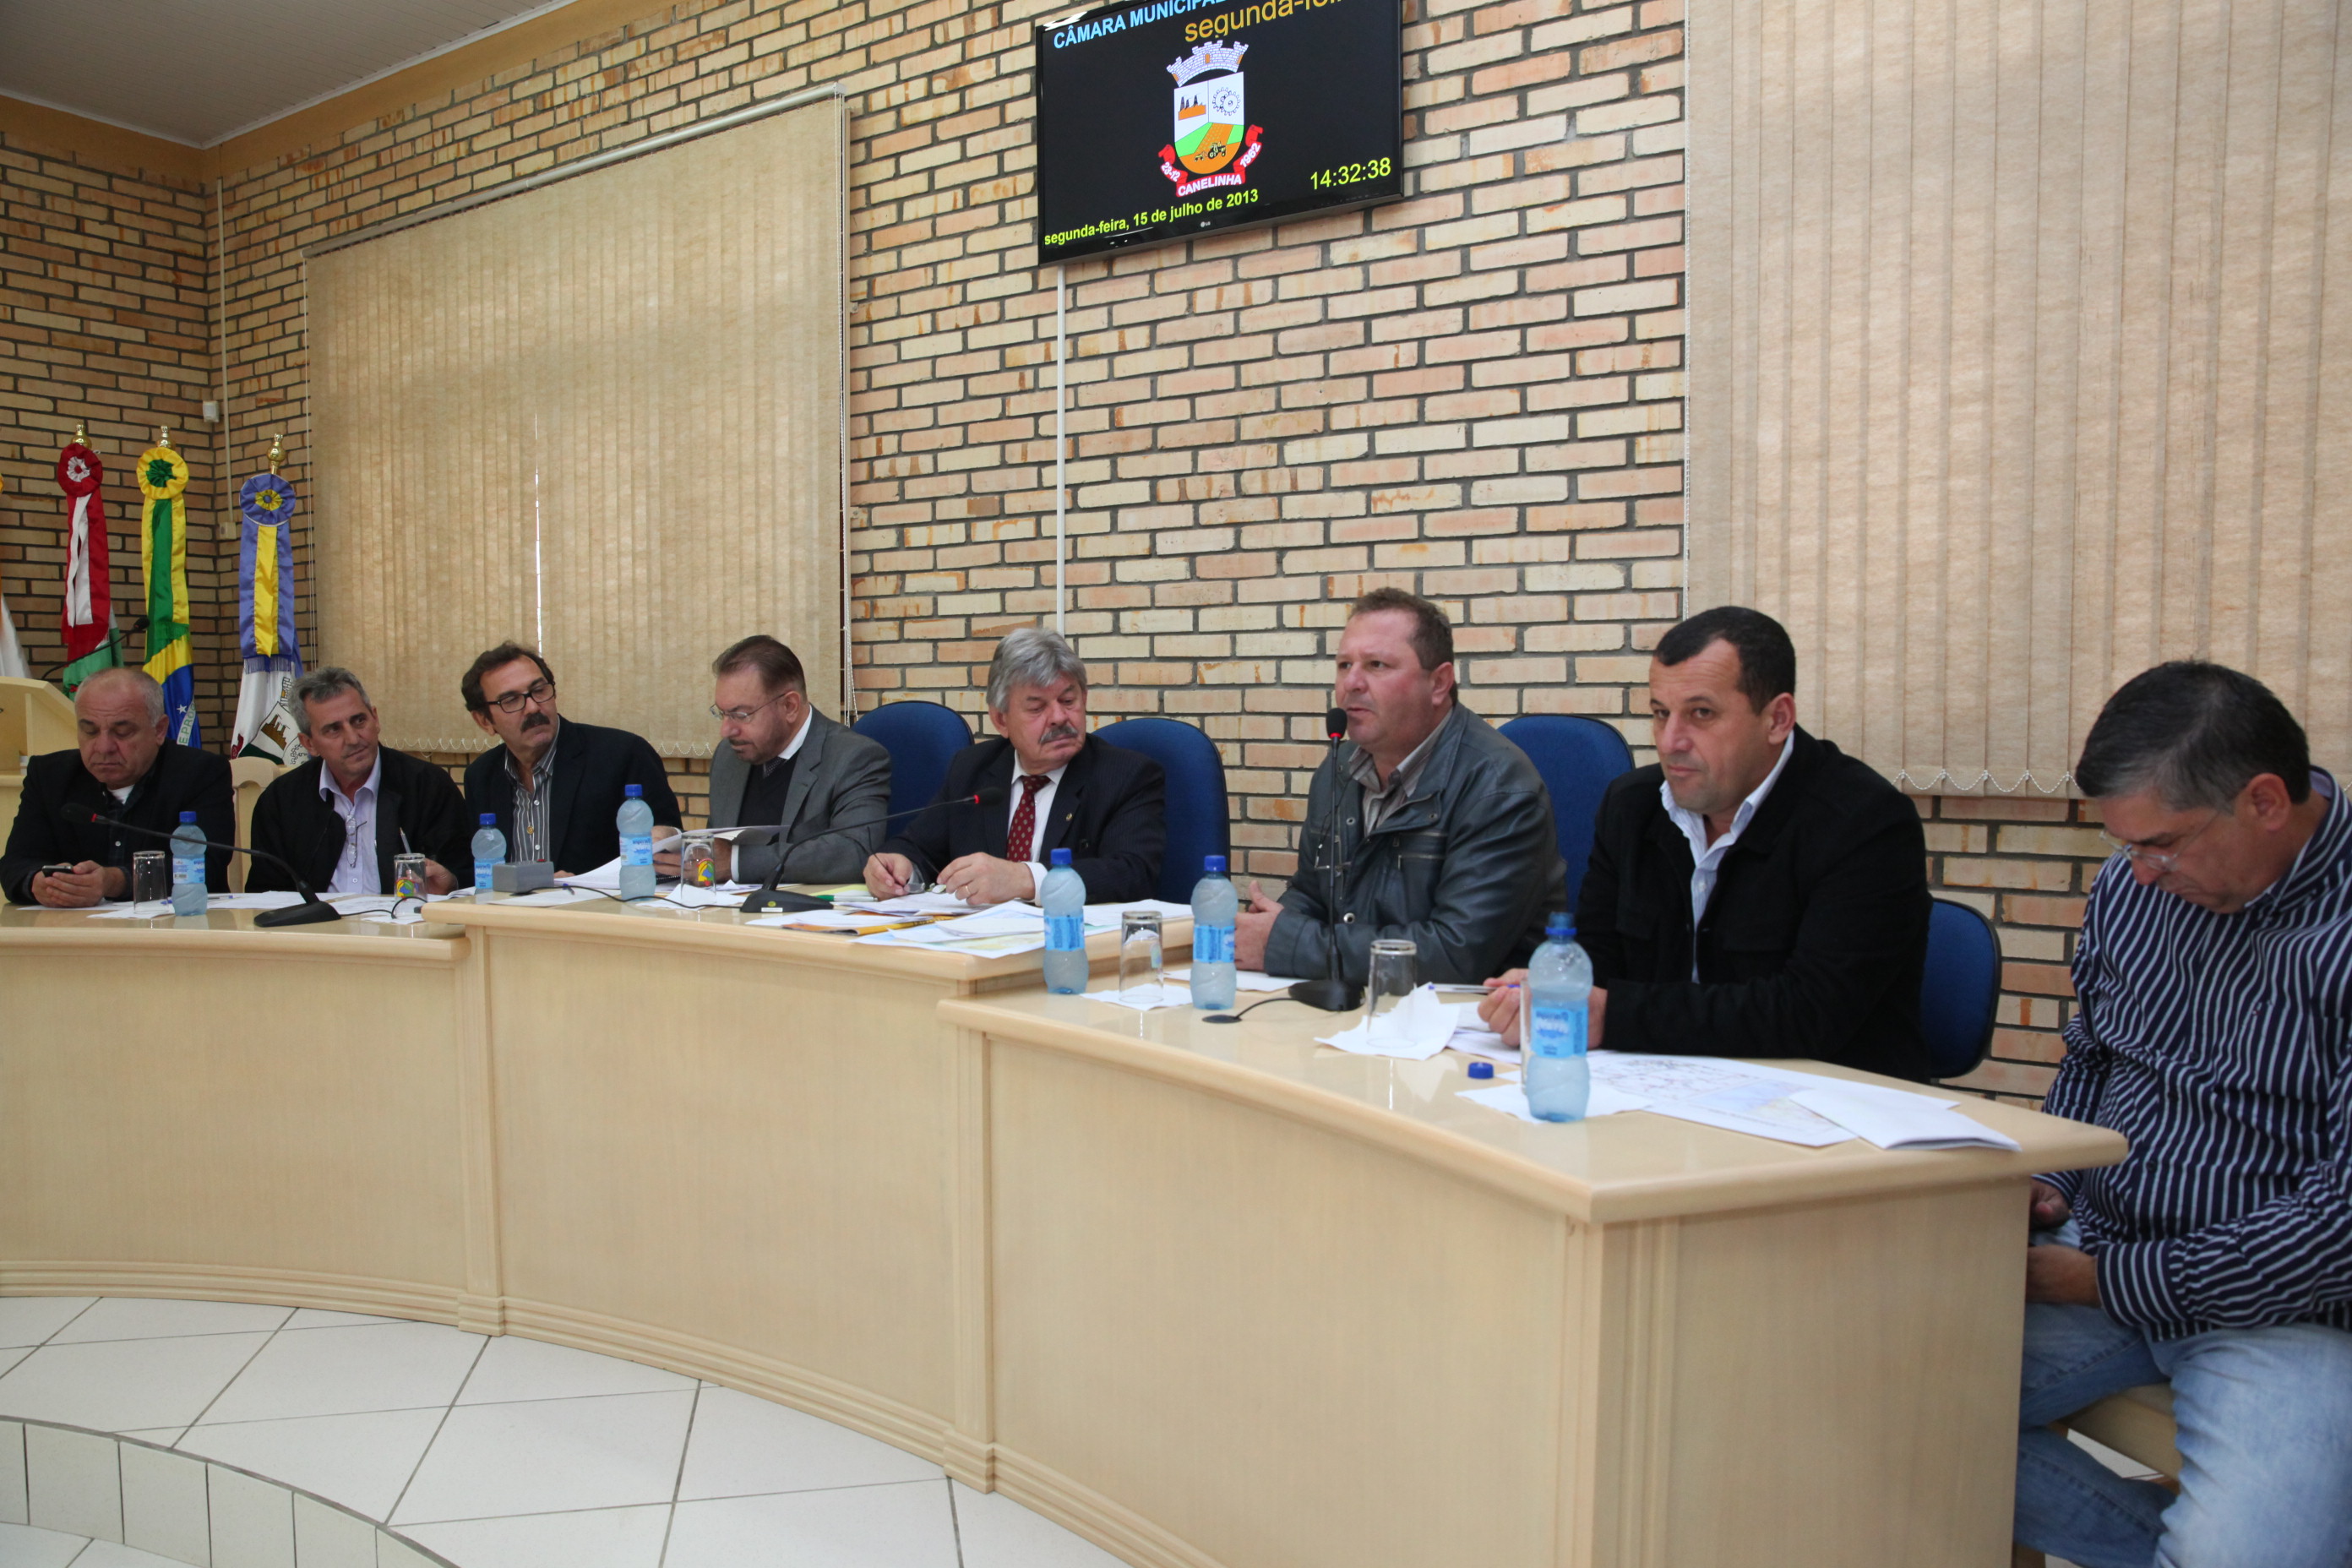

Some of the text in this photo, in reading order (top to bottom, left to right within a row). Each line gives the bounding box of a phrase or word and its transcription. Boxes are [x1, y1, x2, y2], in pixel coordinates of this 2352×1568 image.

[1054, 14, 1126, 49] CÂMARA
[1239, 142, 1261, 167] 1962
[1161, 161, 1181, 182] 23-12
[1178, 174, 1242, 196] CANELINHA
[1310, 157, 1391, 190] 14:32:38
[1044, 188, 1259, 245] segunda-feira, 15 de julho de 2013
